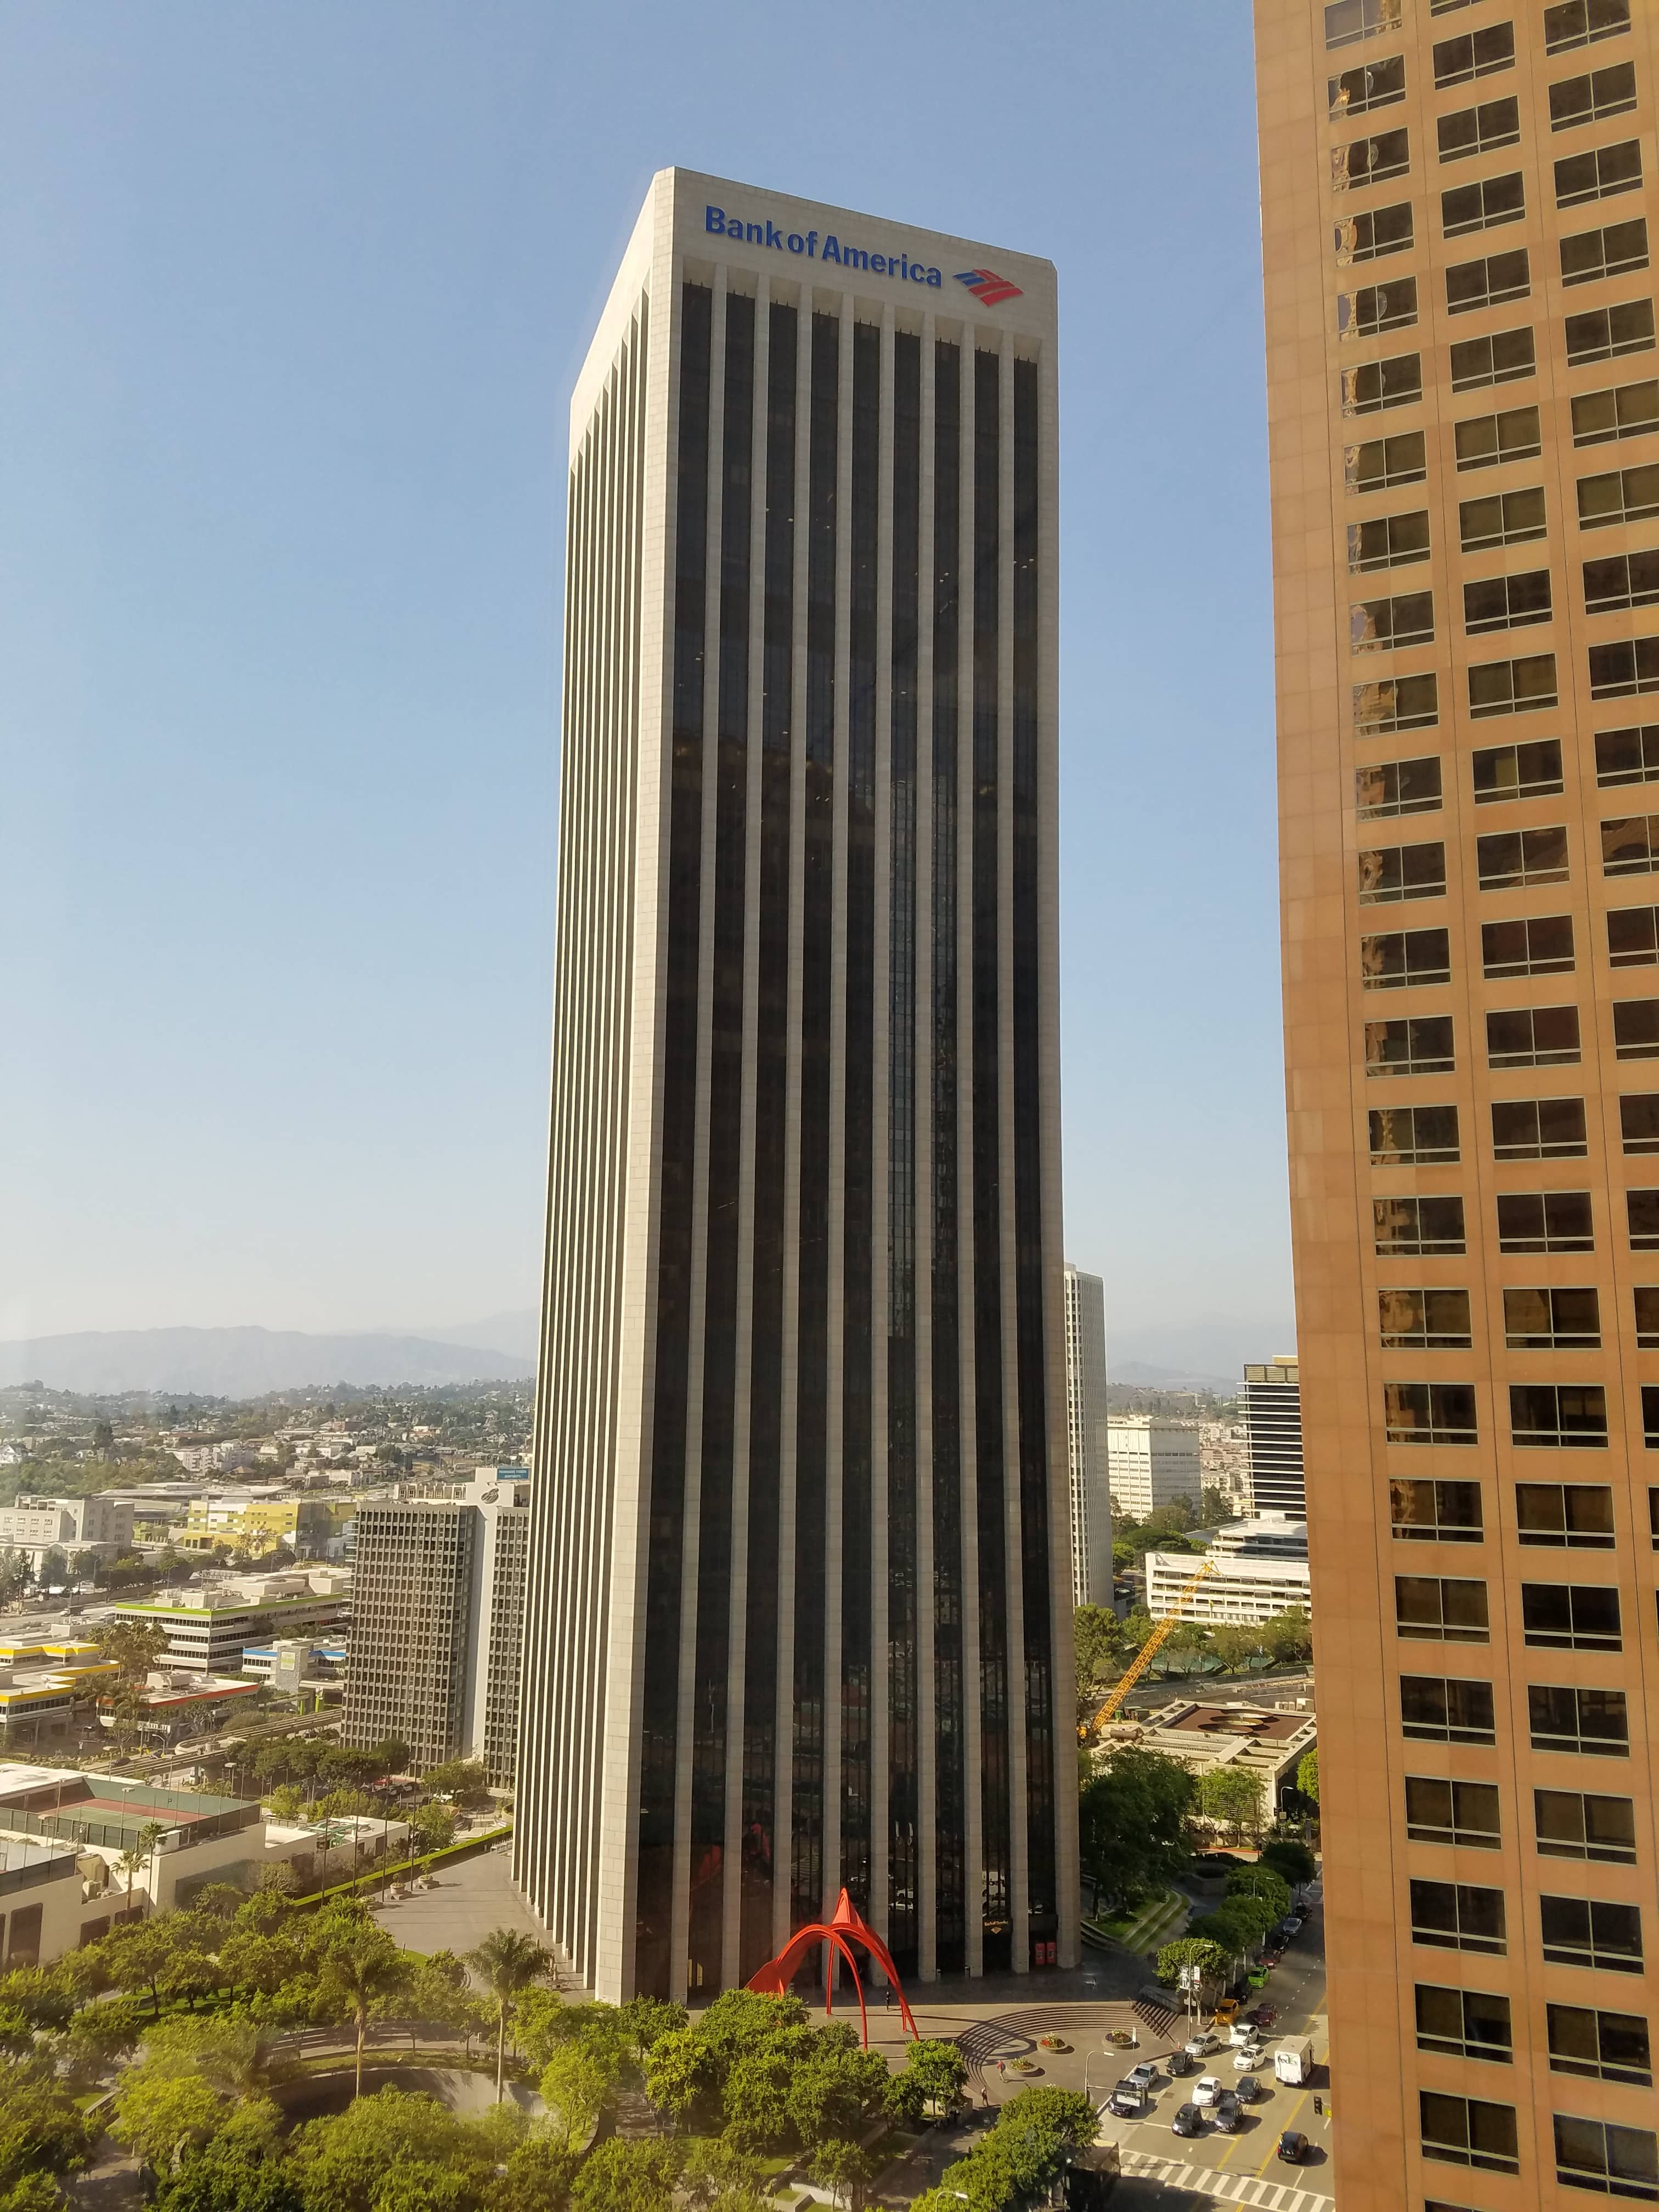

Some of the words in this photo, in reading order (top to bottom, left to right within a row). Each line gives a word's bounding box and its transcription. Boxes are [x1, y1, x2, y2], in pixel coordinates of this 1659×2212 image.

[706, 205, 783, 251] Bank
[787, 230, 817, 257] of
[821, 234, 942, 287] America
